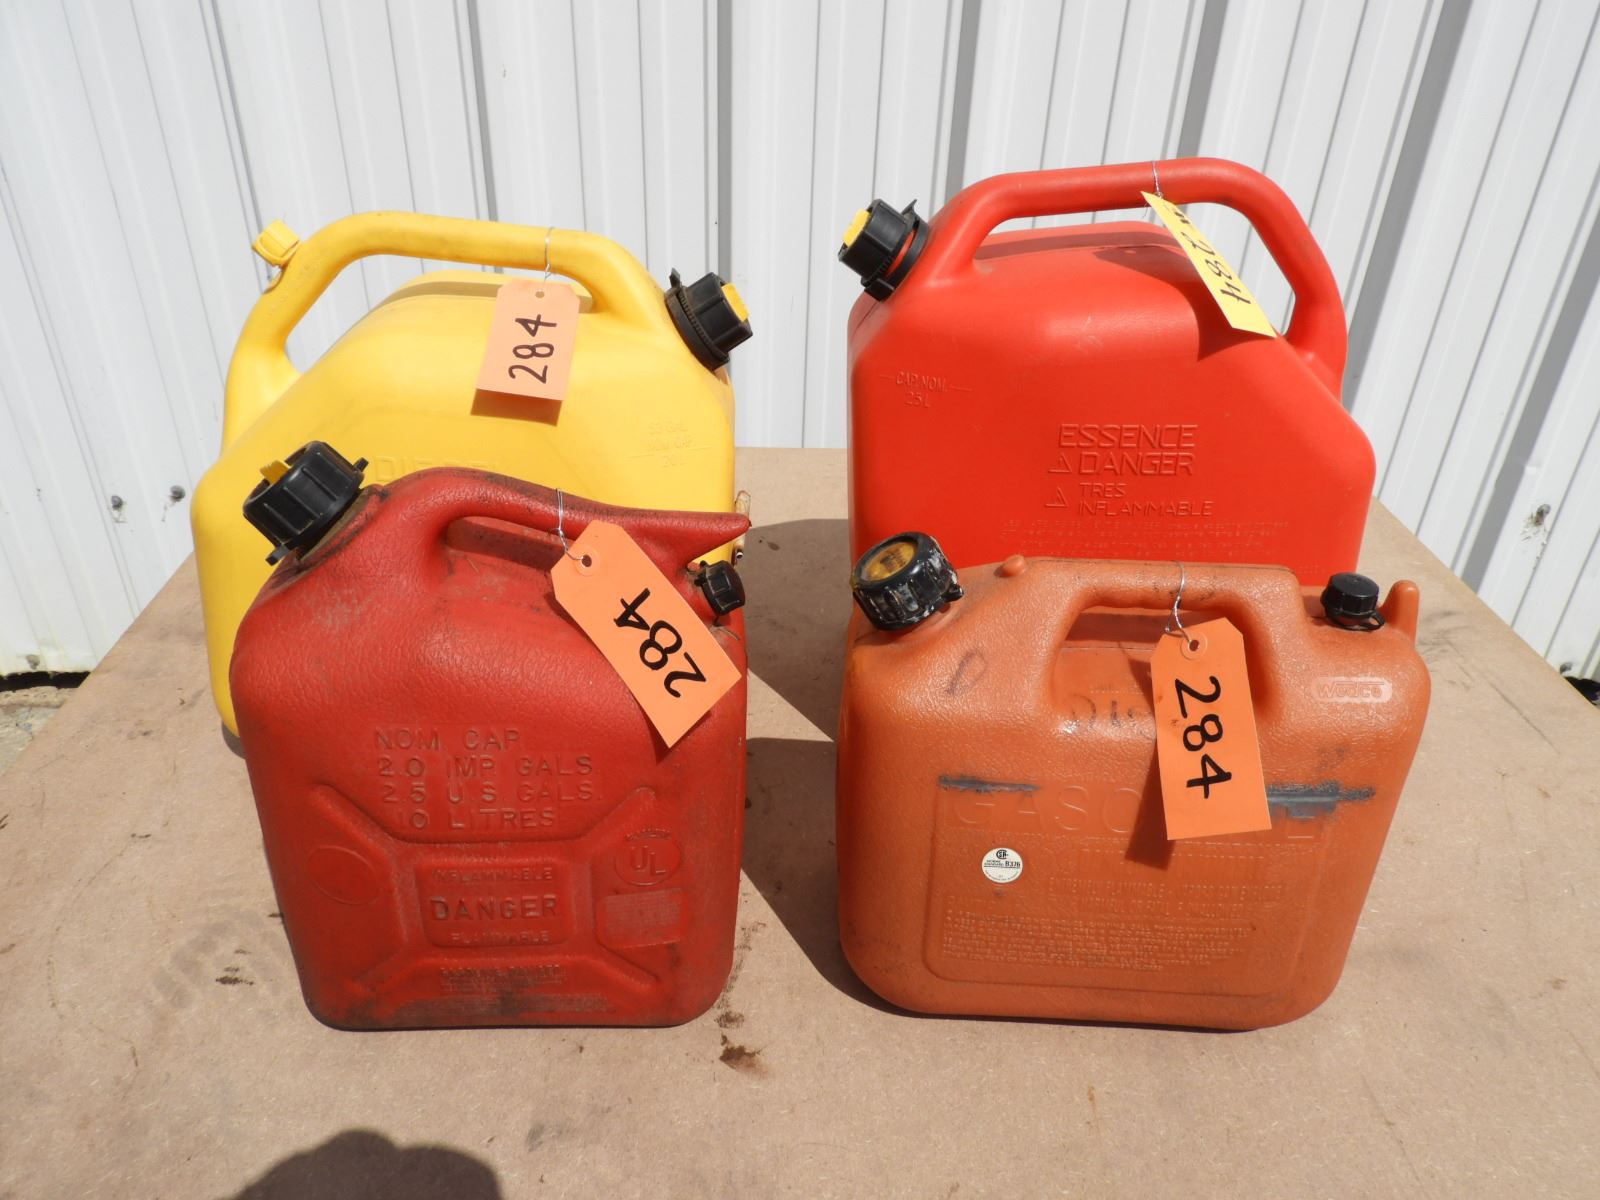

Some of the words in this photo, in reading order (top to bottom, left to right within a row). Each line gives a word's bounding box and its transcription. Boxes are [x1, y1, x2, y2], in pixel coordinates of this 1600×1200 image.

[1180, 230, 1252, 305] 284
[508, 313, 558, 384] 284
[1059, 423, 1198, 449] ESSENCE
[1078, 451, 1196, 476] DANGER
[1079, 482, 1127, 498] TRES
[1078, 500, 1214, 517] INFLAMMABLE
[613, 588, 706, 698] 284
[1175, 675, 1232, 799] 284
[450, 807, 556, 830] LITRES
[430, 894, 557, 921] DANGER
